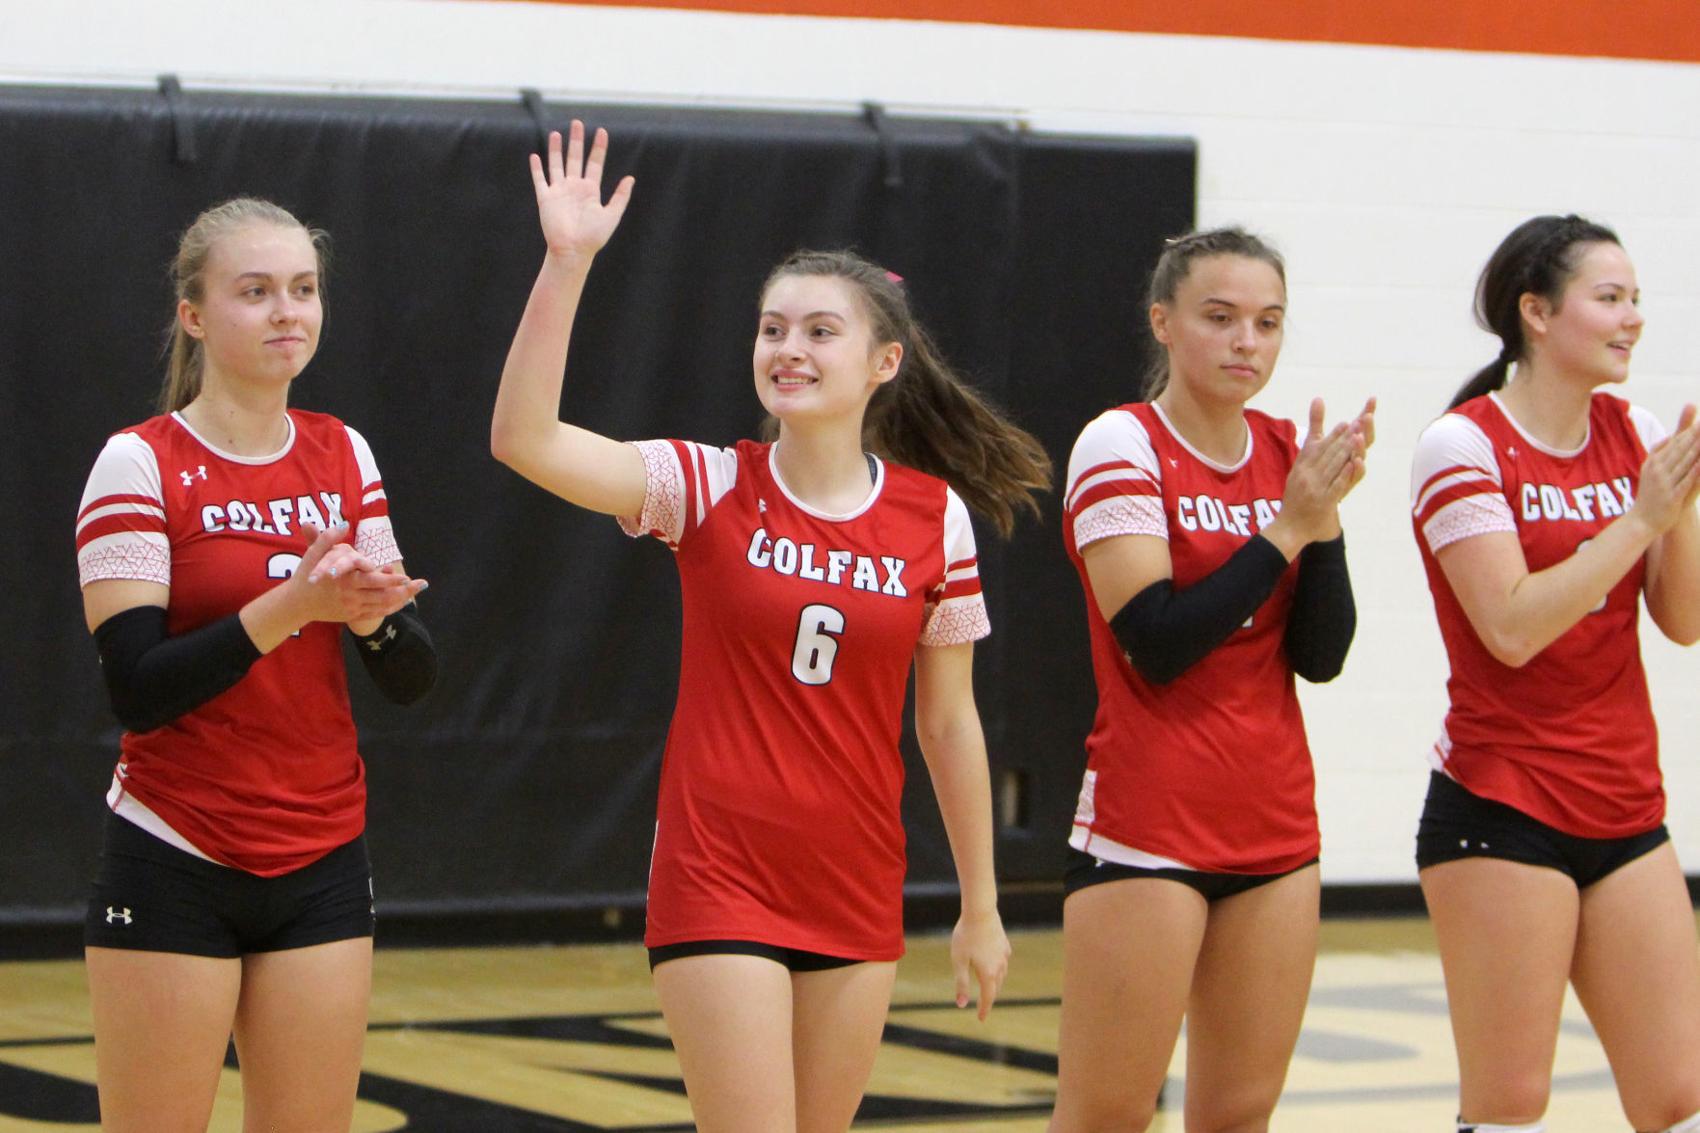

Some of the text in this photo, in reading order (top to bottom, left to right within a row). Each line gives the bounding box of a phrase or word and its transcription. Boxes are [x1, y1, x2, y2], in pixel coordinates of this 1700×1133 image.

[201, 491, 345, 536] COLFAX
[1178, 494, 1283, 536] COLFA
[1521, 475, 1635, 521] COLFAX
[747, 527, 908, 598] COLFAX
[791, 603, 846, 686] 6
